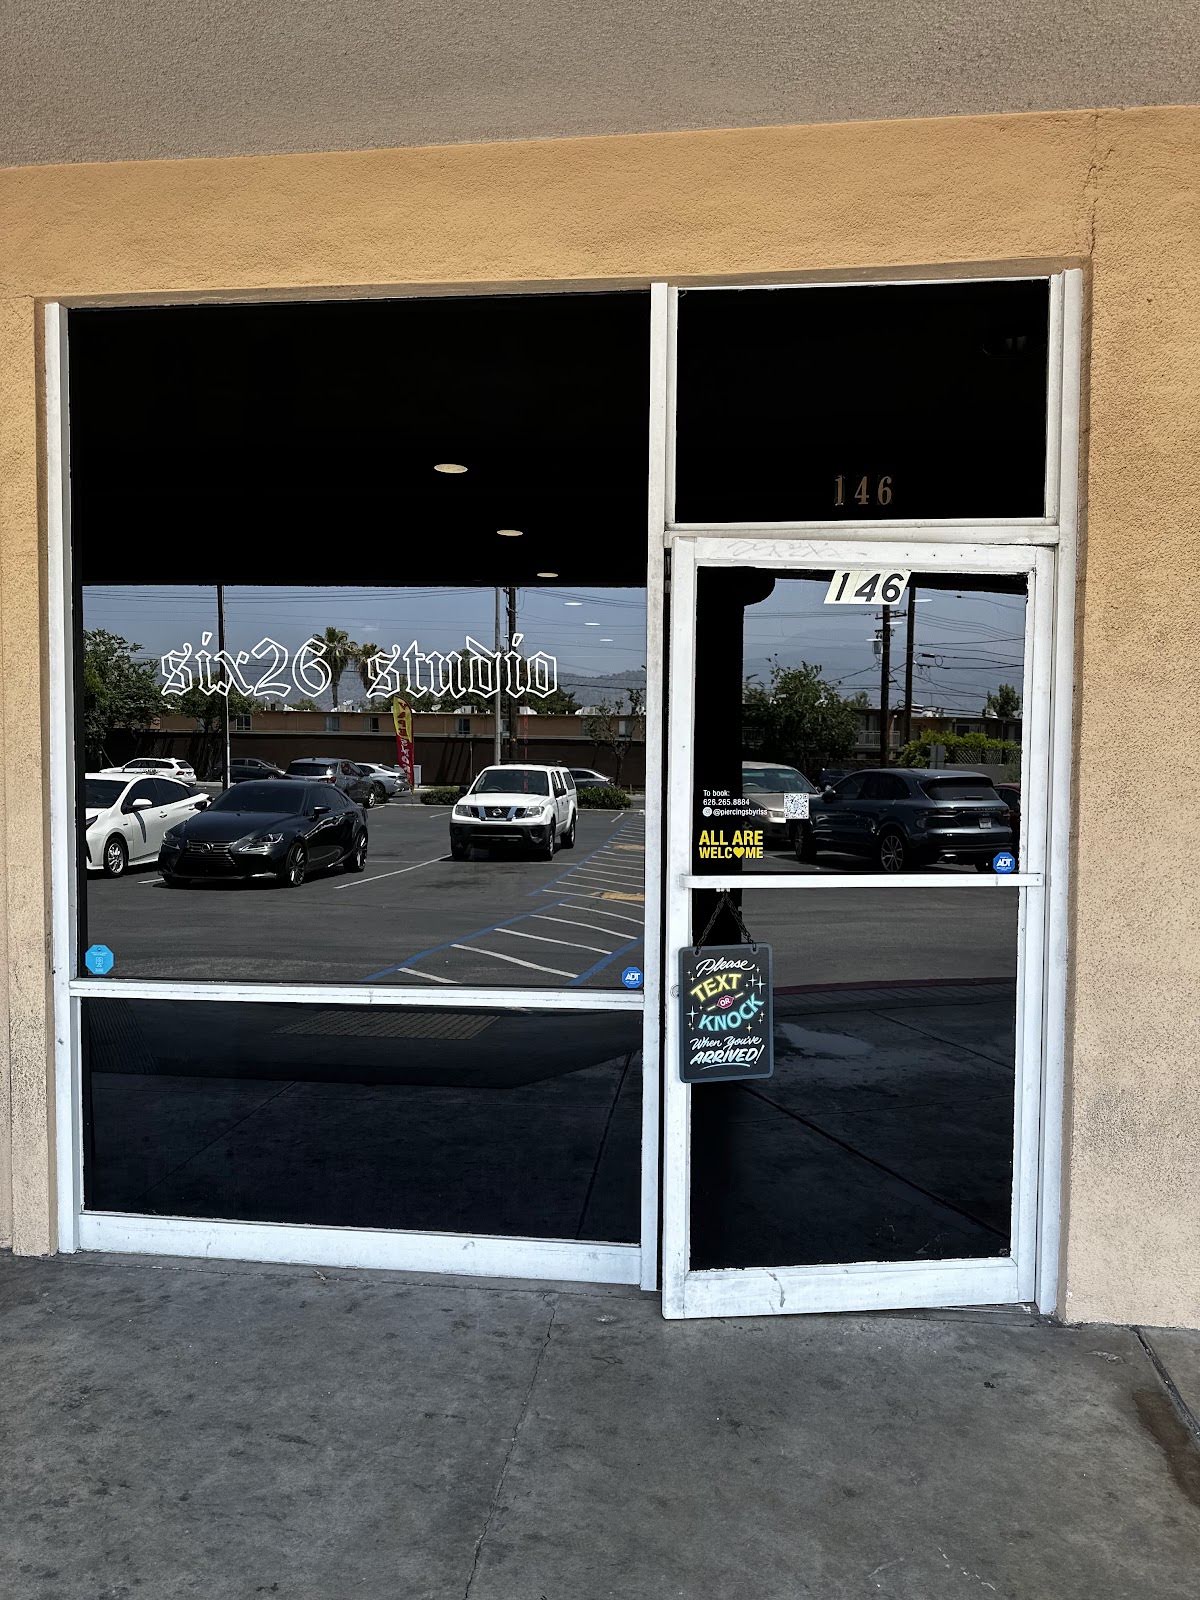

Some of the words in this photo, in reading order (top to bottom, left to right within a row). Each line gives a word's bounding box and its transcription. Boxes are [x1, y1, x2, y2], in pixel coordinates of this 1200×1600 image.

[834, 475, 893, 506] 146
[834, 572, 905, 603] 146
[160, 631, 332, 697] six26
[366, 633, 558, 698] studio
[712, 789, 730, 797] book:
[713, 808, 768, 817] @piercingsbyriss
[699, 829, 729, 846] ALL
[731, 829, 764, 846] ARE
[695, 956, 756, 978] Please
[690, 973, 742, 1003] TEXT
[698, 993, 765, 1032] KNOCK
[720, 997, 731, 1007] OR
[689, 1036, 722, 1051] When
[722, 1035, 762, 1051] You've
[689, 1044, 765, 1065] ARRIVED!
